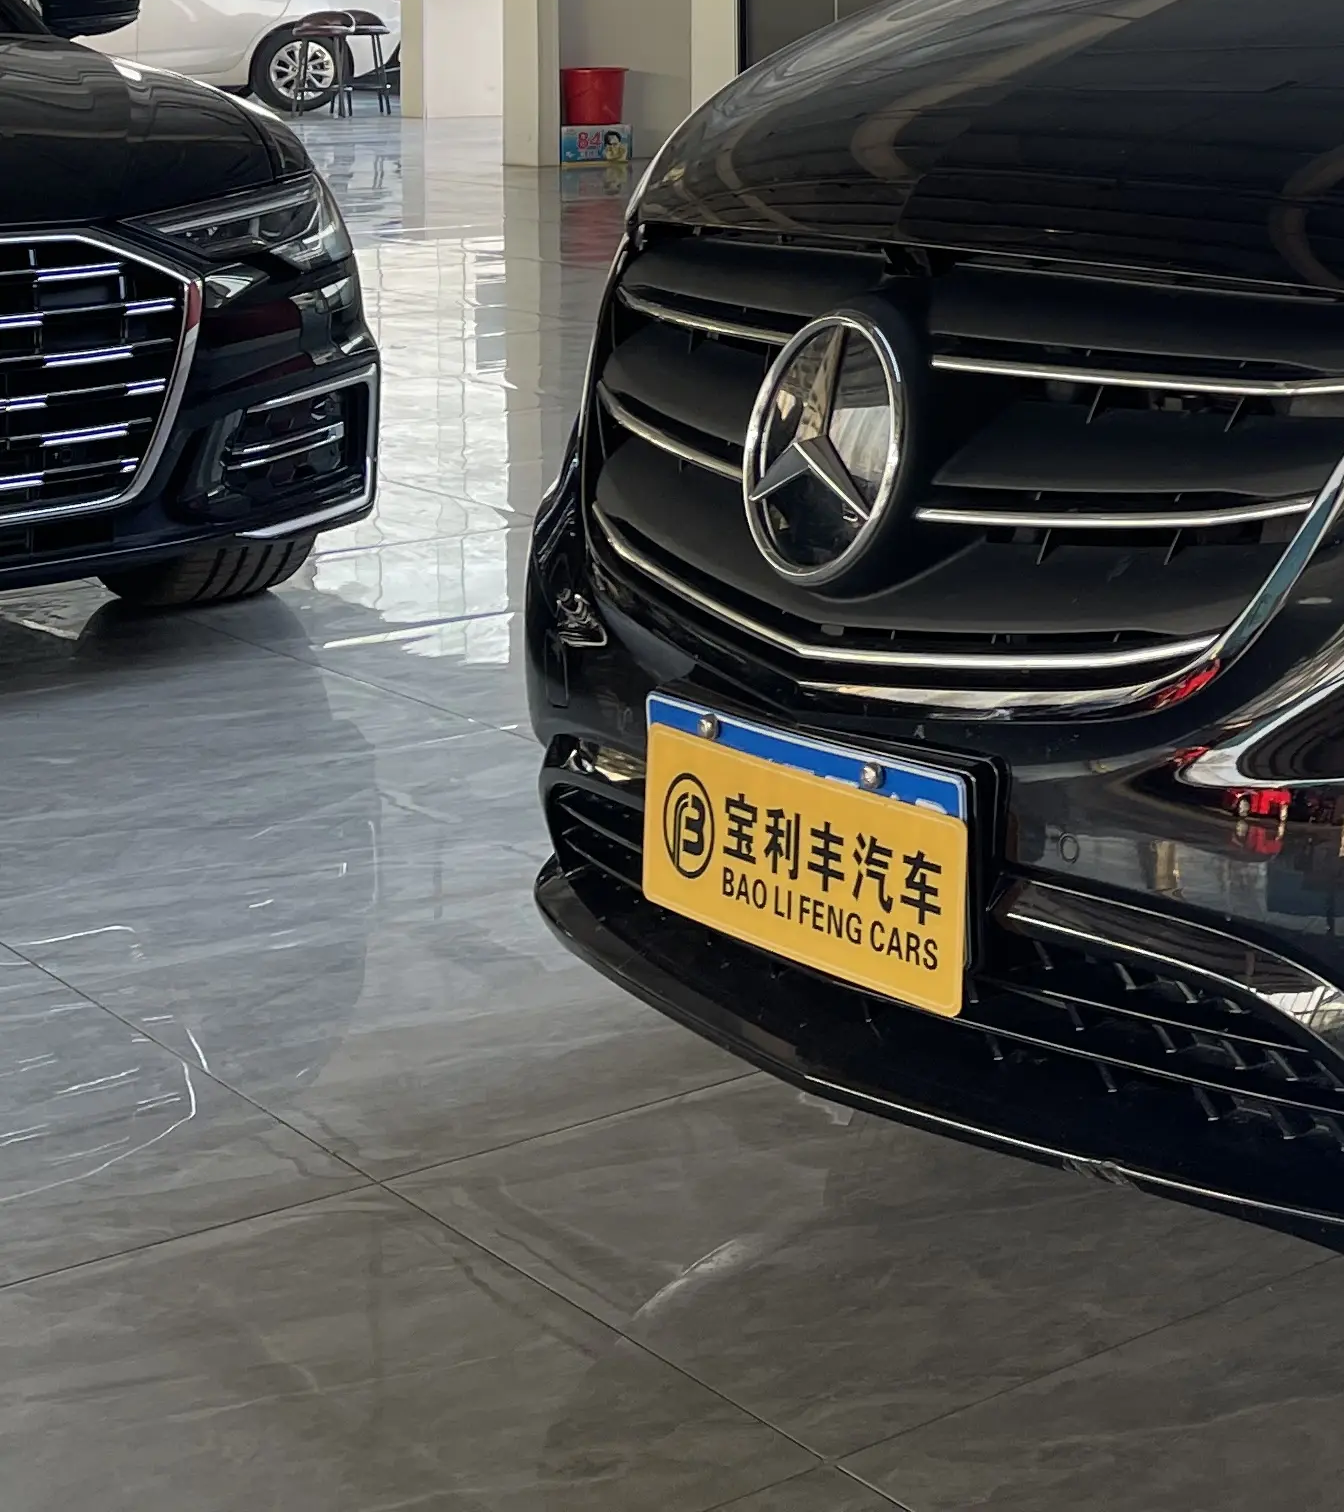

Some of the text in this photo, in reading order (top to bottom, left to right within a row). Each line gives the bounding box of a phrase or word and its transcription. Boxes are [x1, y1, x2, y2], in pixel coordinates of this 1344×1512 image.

[577, 131, 602, 150] 84
[722, 793, 943, 926] 宝利丰汽车
[722, 866, 939, 971] BAO LI FENG CARS
